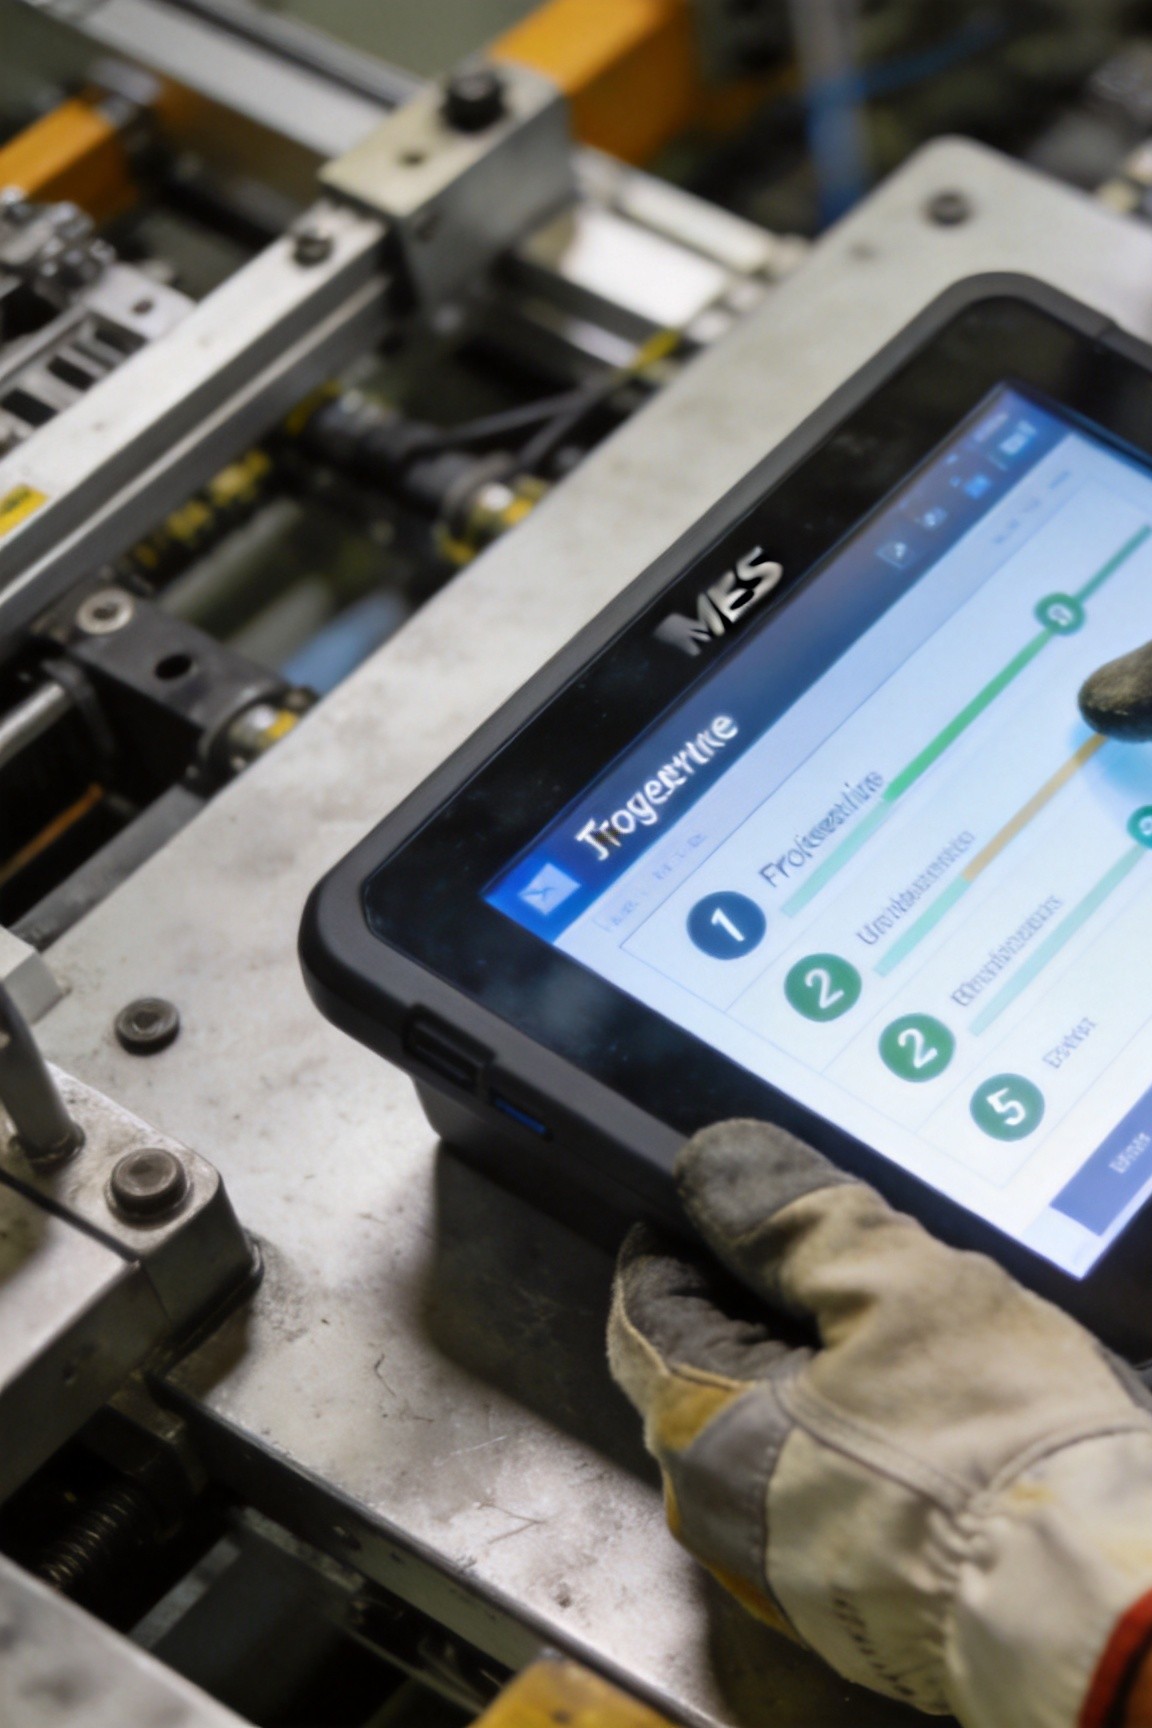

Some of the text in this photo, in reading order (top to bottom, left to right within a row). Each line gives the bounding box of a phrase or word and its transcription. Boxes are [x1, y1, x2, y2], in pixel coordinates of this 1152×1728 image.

[654, 546, 783, 656] MES
[710, 908, 745, 943] 1
[805, 967, 844, 1009] 2
[899, 1027, 939, 1068] 2
[987, 1087, 1027, 1126] 5
